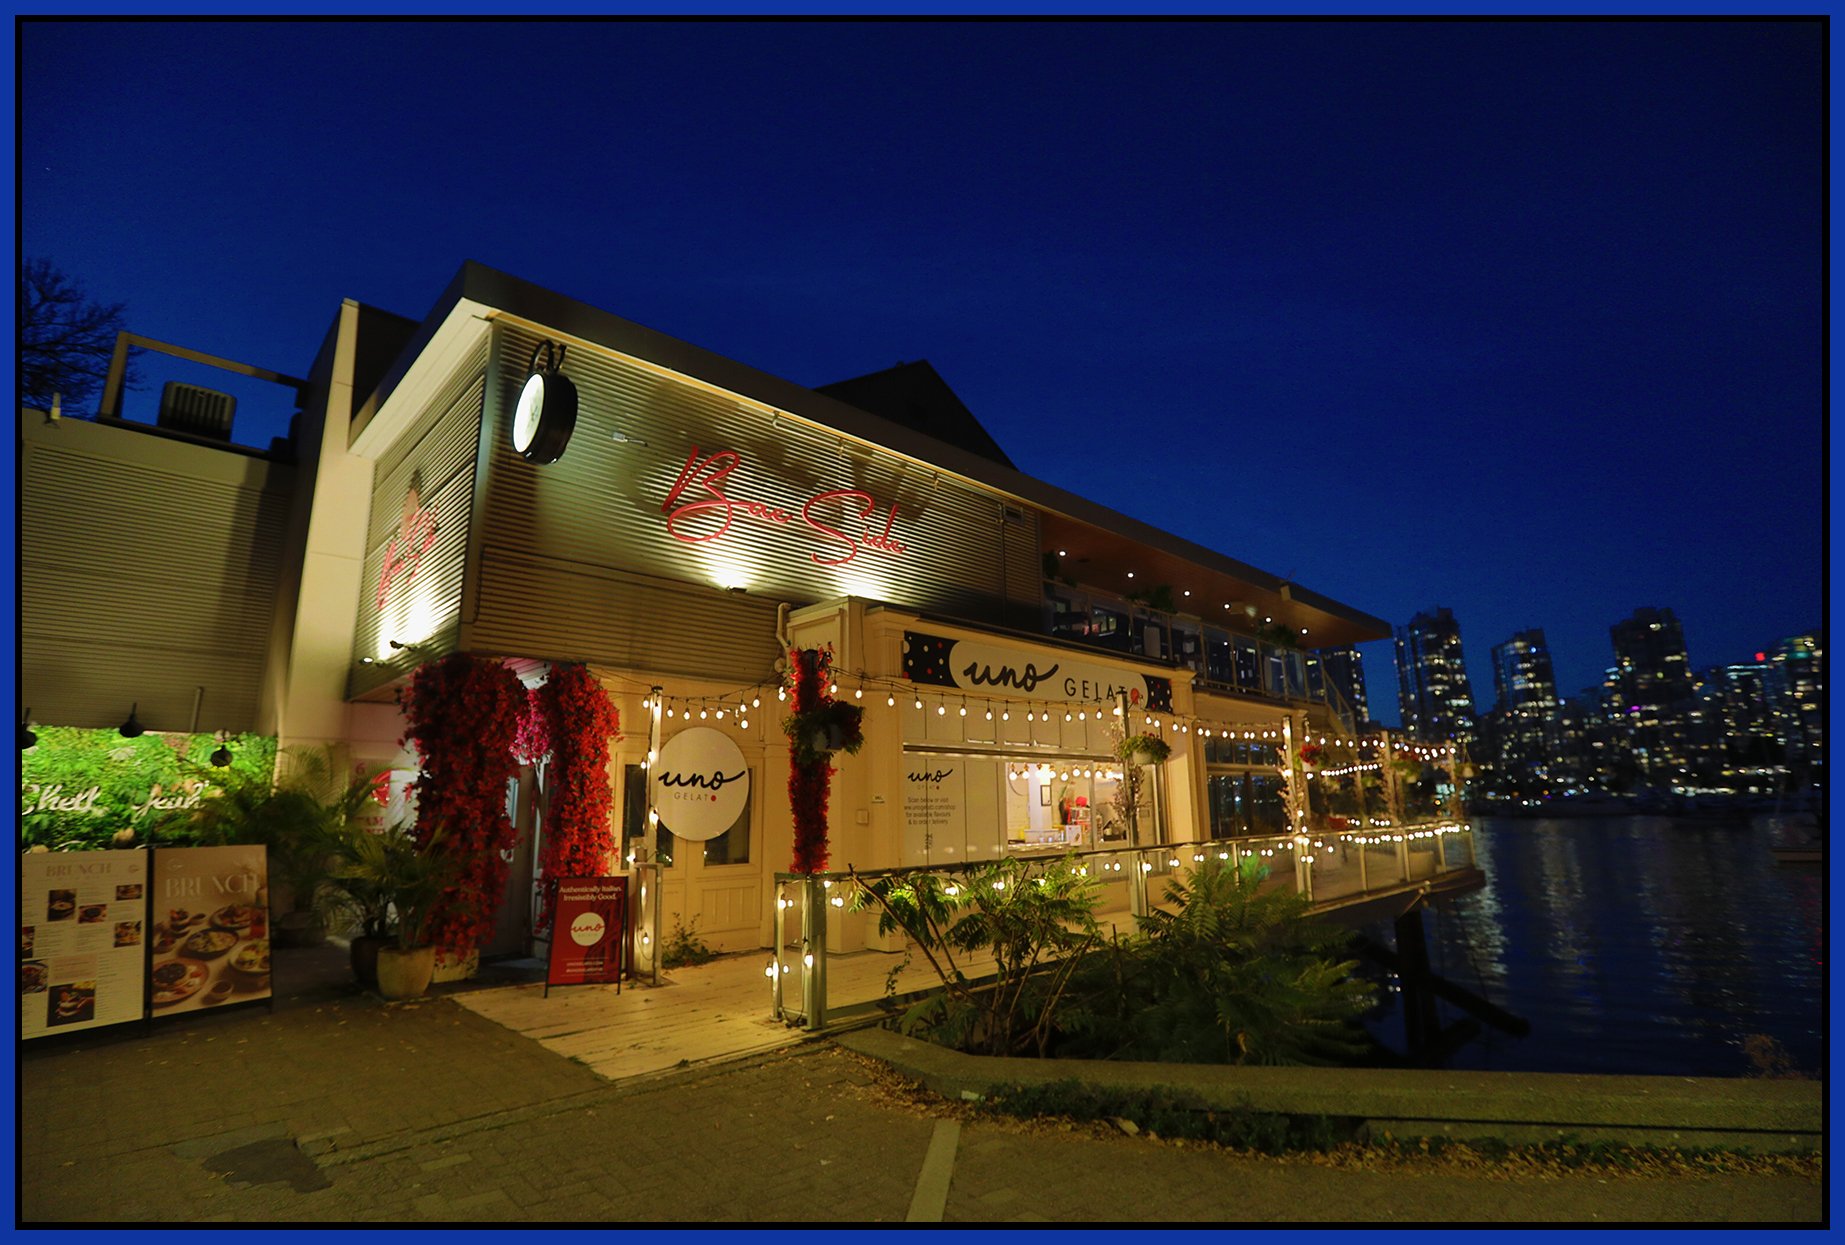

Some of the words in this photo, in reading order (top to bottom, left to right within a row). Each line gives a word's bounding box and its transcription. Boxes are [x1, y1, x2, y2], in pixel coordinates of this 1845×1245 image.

[661, 445, 793, 542] Bae
[802, 488, 908, 565] Side
[963, 661, 1060, 693] uno
[658, 770, 746, 791] uno
[908, 768, 953, 783] uno
[674, 791, 717, 802] GELATO
[45, 862, 112, 877] BRUNCH
[165, 873, 259, 898] BRUNCH
[559, 885, 600, 894] Authentically
[563, 893, 597, 902] Irresistibly
[570, 922, 605, 933] uno
